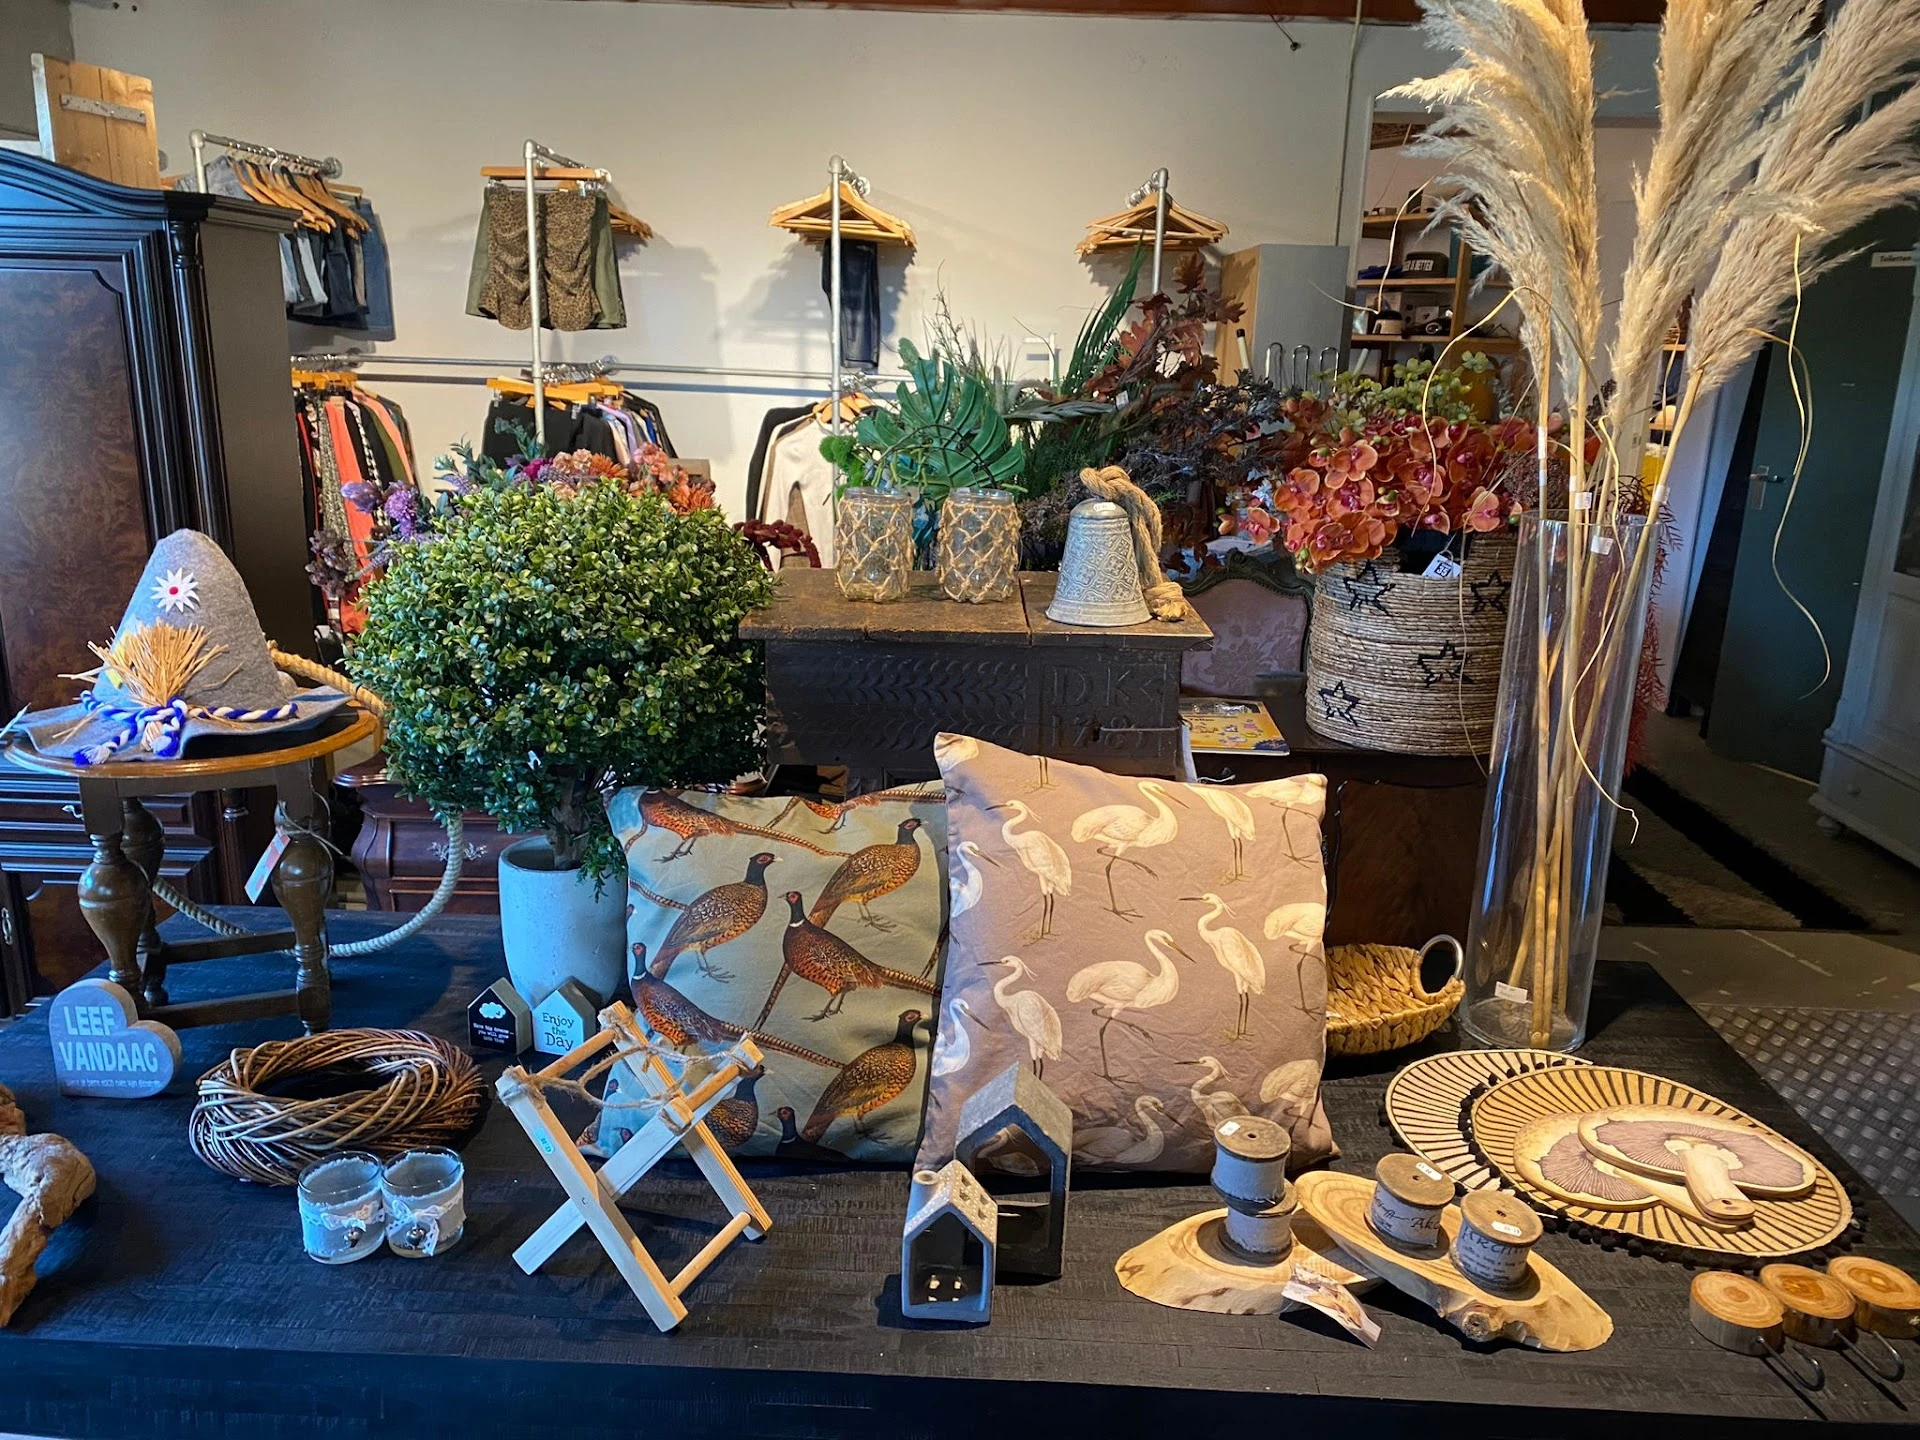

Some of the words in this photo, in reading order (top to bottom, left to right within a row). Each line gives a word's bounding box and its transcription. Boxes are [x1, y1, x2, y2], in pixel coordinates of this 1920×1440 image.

[1437, 565, 1449, 576] 35
[63, 1006, 115, 1035] LEEF
[542, 1012, 575, 1028] Enjoy
[552, 1026, 566, 1036] the
[545, 1032, 574, 1051] Day
[58, 1042, 158, 1072] VANDAAG
